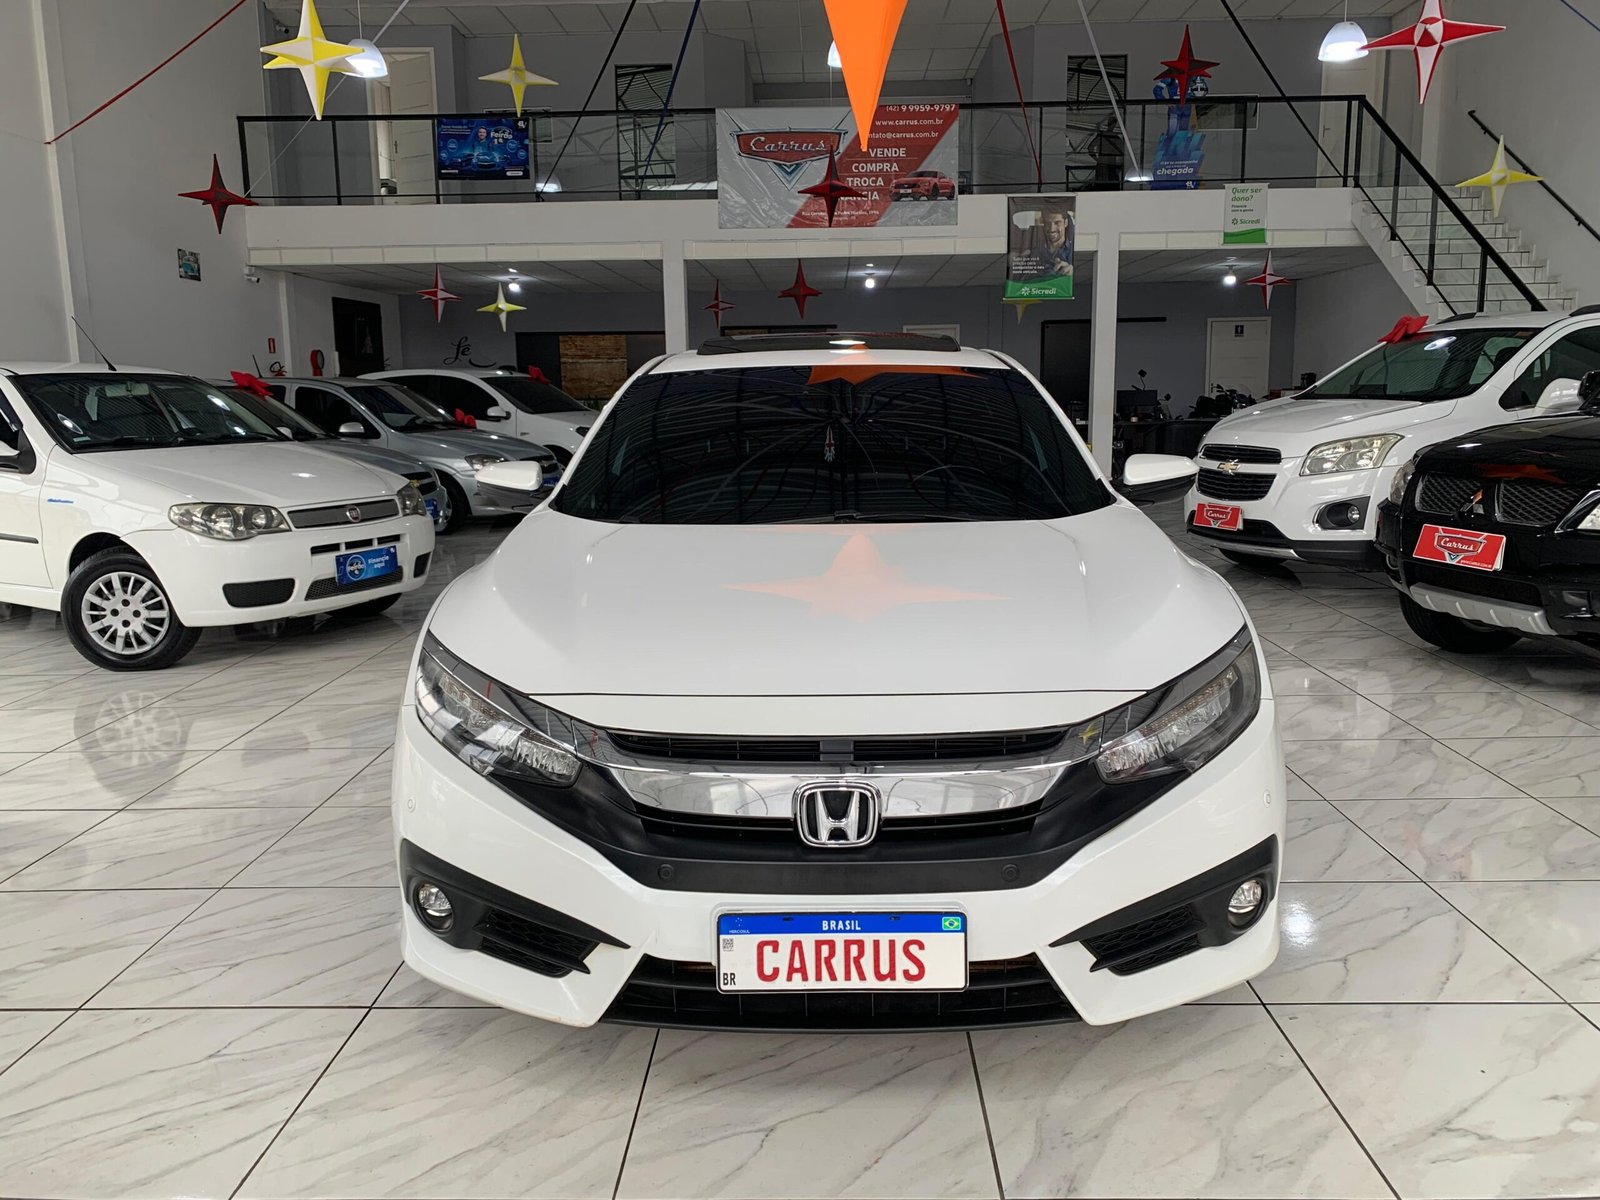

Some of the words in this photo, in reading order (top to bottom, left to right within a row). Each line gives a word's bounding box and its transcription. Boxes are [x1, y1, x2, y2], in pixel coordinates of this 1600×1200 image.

[908, 104, 956, 112] 9959-9797
[875, 118, 944, 126] www.carrus.com.br
[868, 131, 939, 139] ntato@carrus.com.br
[750, 136, 827, 152] Carrus
[869, 148, 906, 157] VENDE
[852, 163, 899, 172] COMPRA
[1157, 166, 1194, 176] chegada
[847, 177, 884, 187] TROCA
[1231, 187, 1249, 195] Quer
[1031, 287, 1057, 295] Sicredi
[1441, 538, 1474, 551] Carrus
[821, 920, 862, 931] BRASIL
[756, 939, 926, 983] CARRUS
[722, 972, 736, 986] BR
